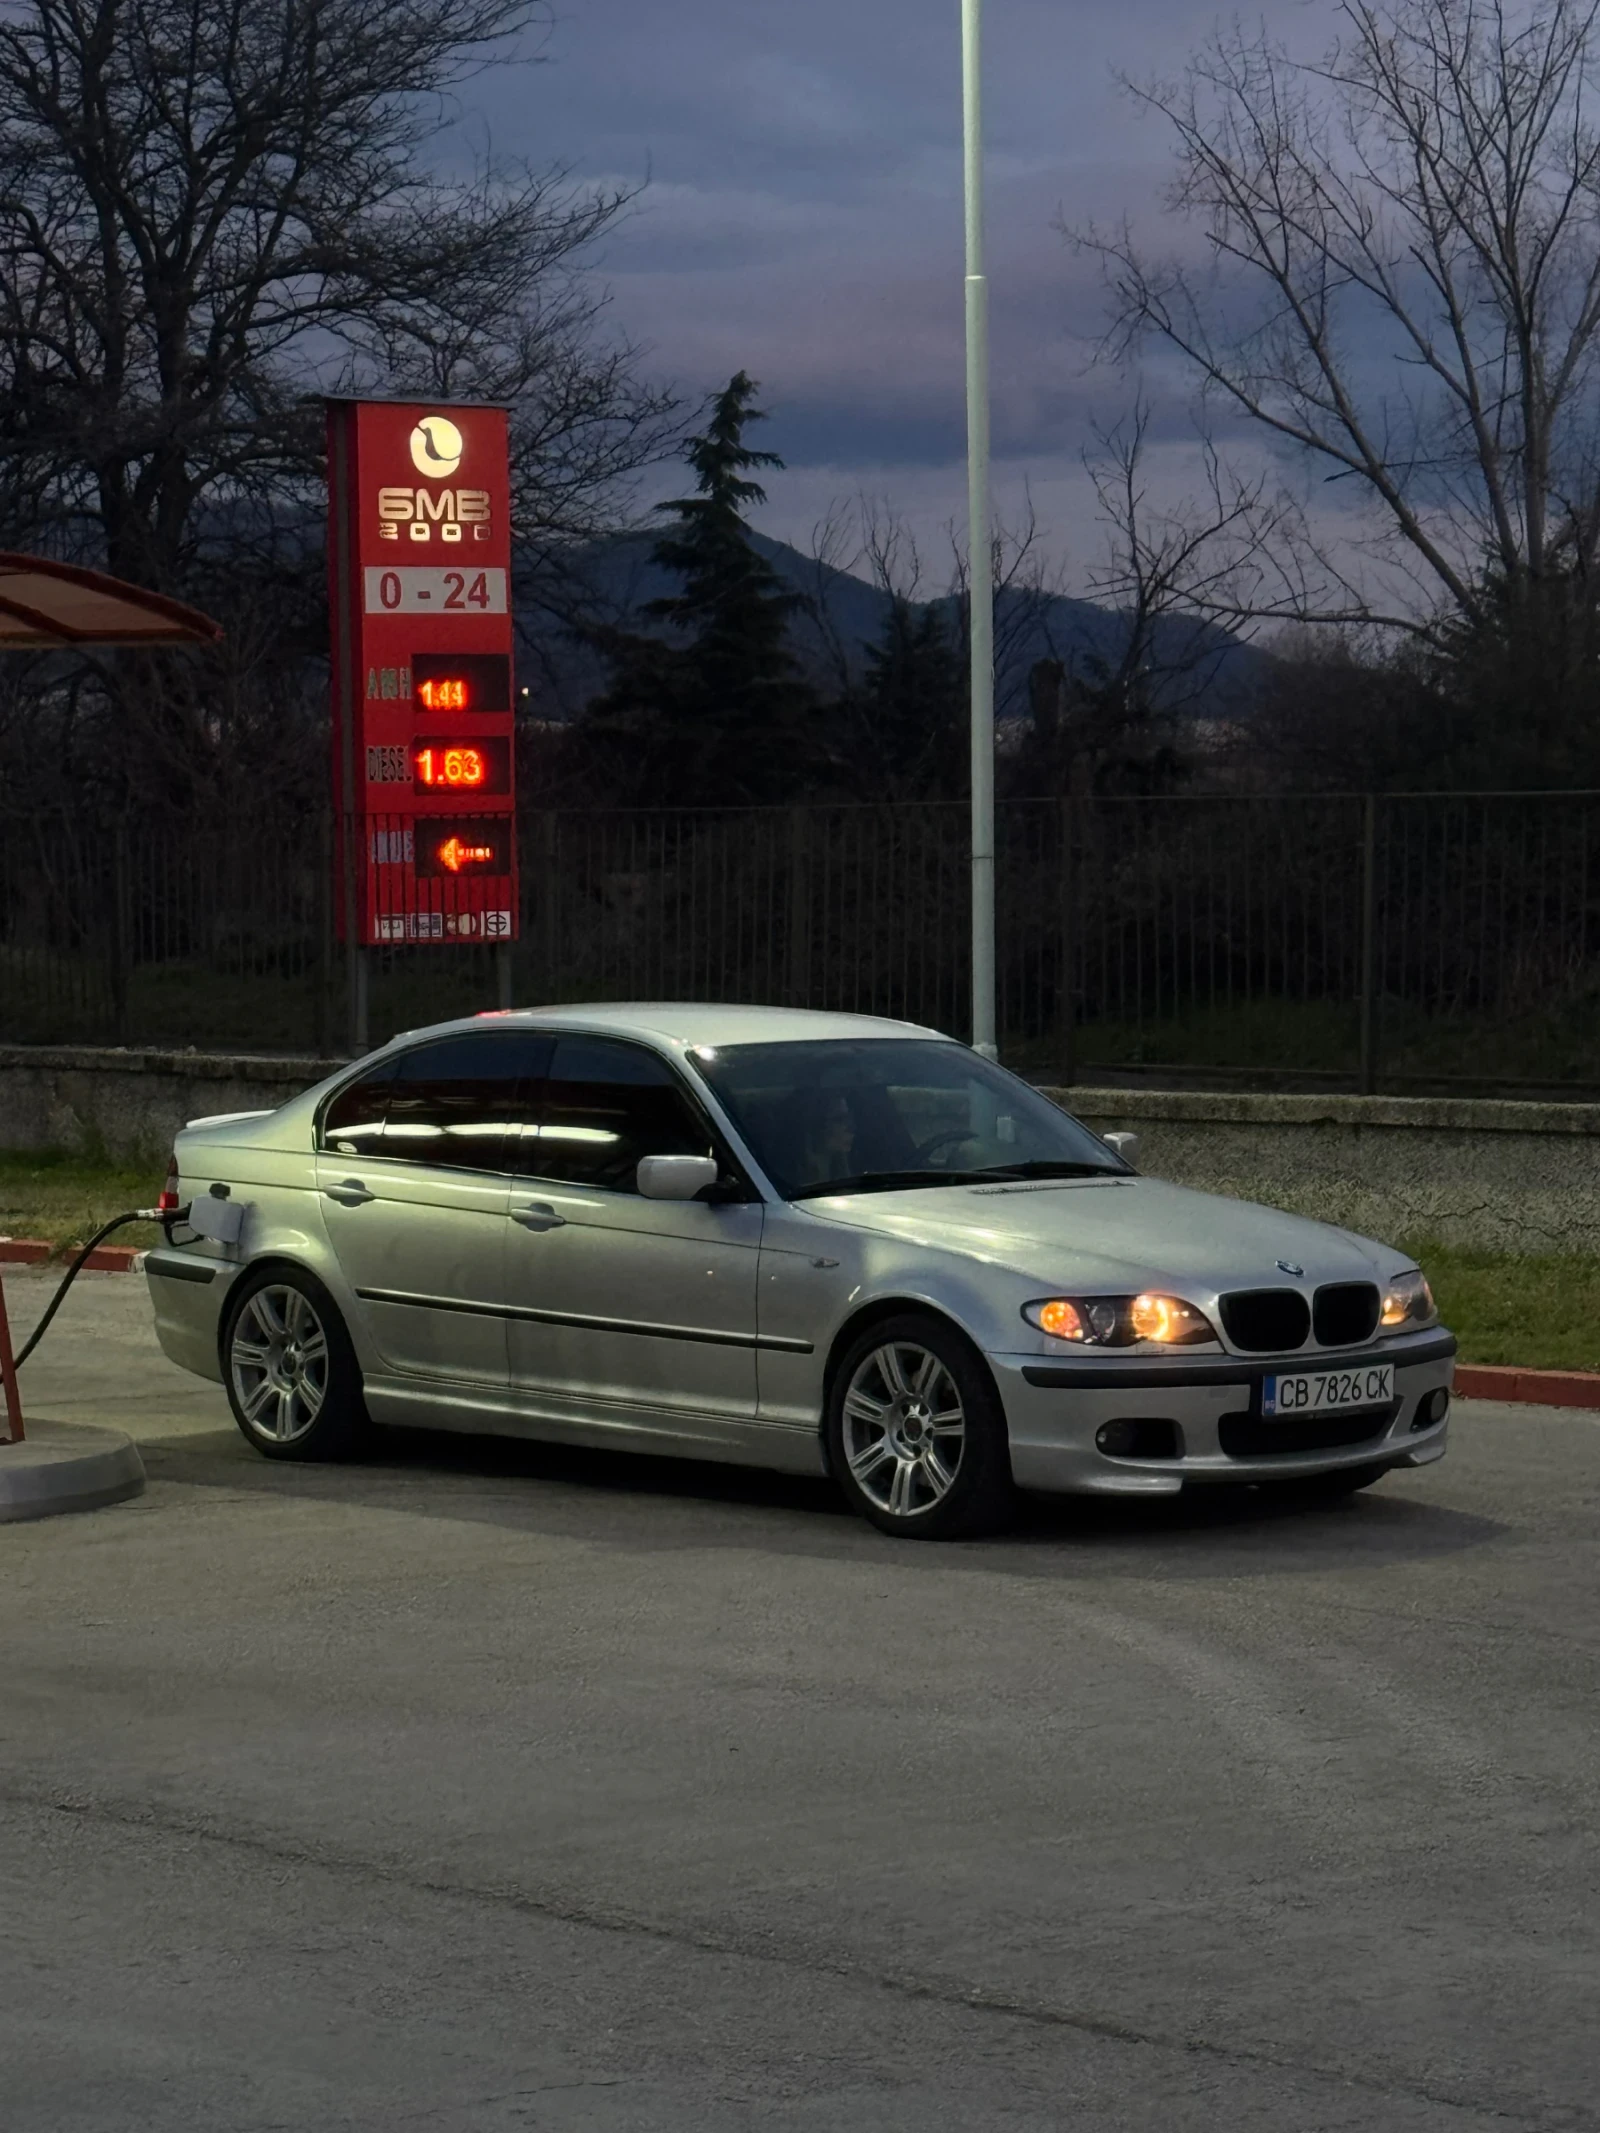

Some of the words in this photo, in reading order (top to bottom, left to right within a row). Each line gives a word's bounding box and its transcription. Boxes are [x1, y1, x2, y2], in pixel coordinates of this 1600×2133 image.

[380, 571, 402, 609] 0
[443, 572, 490, 609] 24
[417, 749, 482, 784] 1.63
[1280, 1378, 1309, 1408] CB
[1314, 1372, 1362, 1406] 7826
[1366, 1368, 1390, 1399] CK
